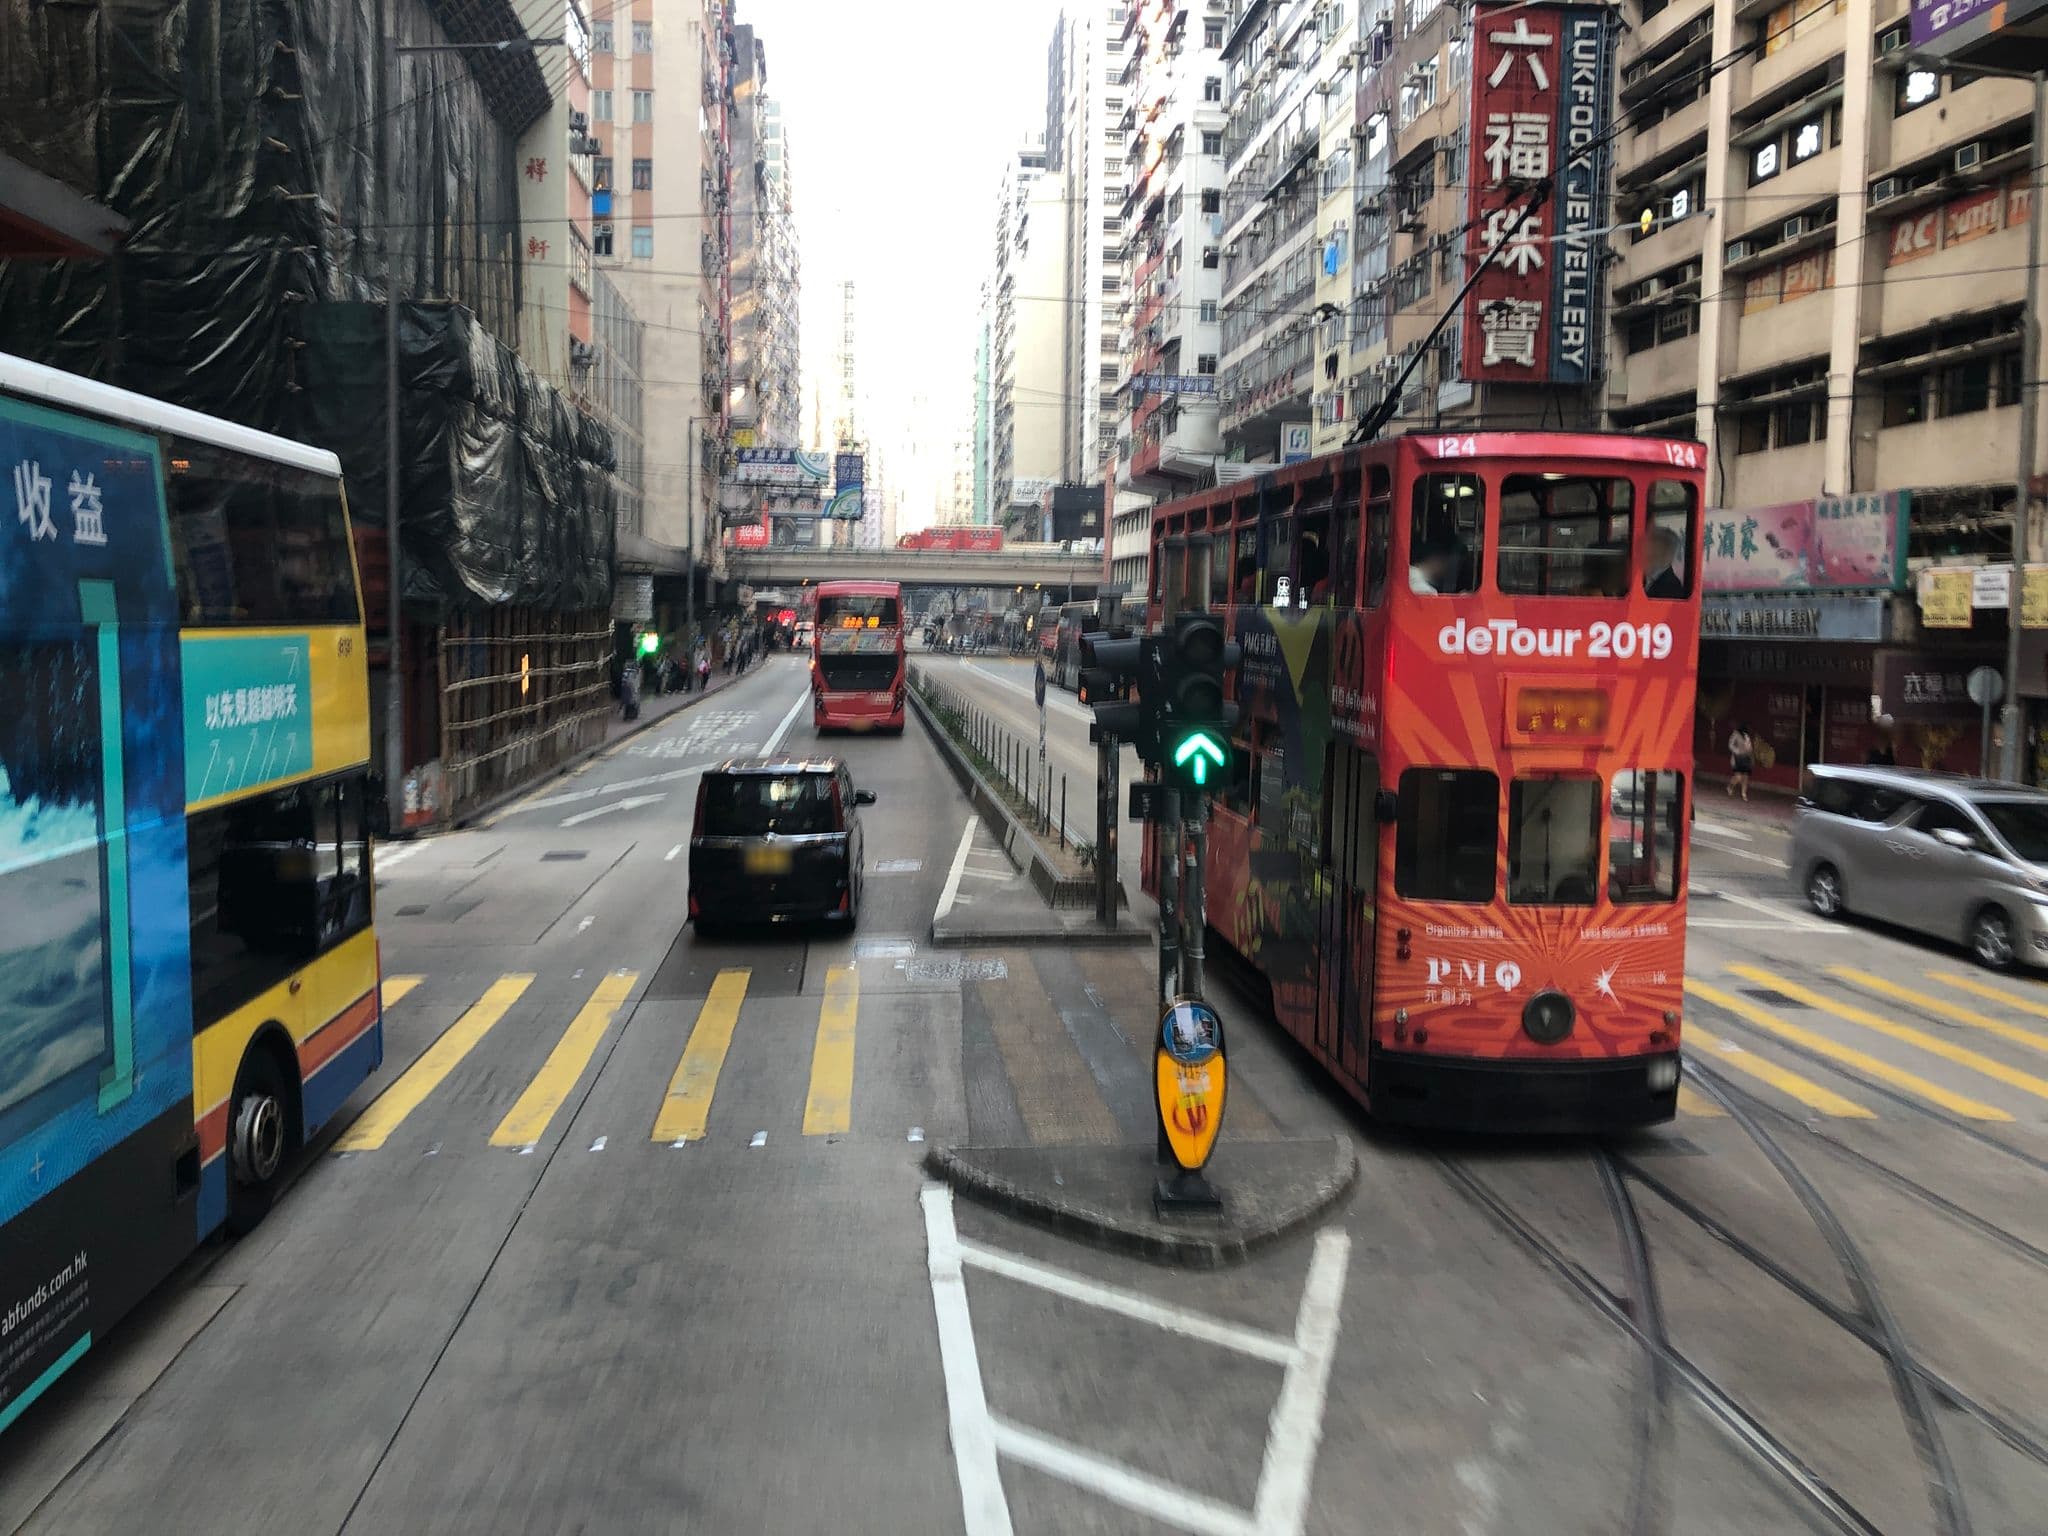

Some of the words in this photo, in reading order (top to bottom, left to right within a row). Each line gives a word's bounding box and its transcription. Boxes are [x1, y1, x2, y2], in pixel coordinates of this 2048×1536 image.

[1568, 20, 1598, 170] LUKFOOK
[1474, 18, 1553, 368] 六福珠寶
[1561, 180, 1590, 368] JEWELLERY
[1438, 437, 1477, 458] 124
[1665, 443, 1696, 468] 124
[14, 459, 107, 546] 收益
[1439, 618, 1582, 656] deTour
[1588, 621, 1673, 660] 2019
[1426, 957, 1522, 992] PMQ
